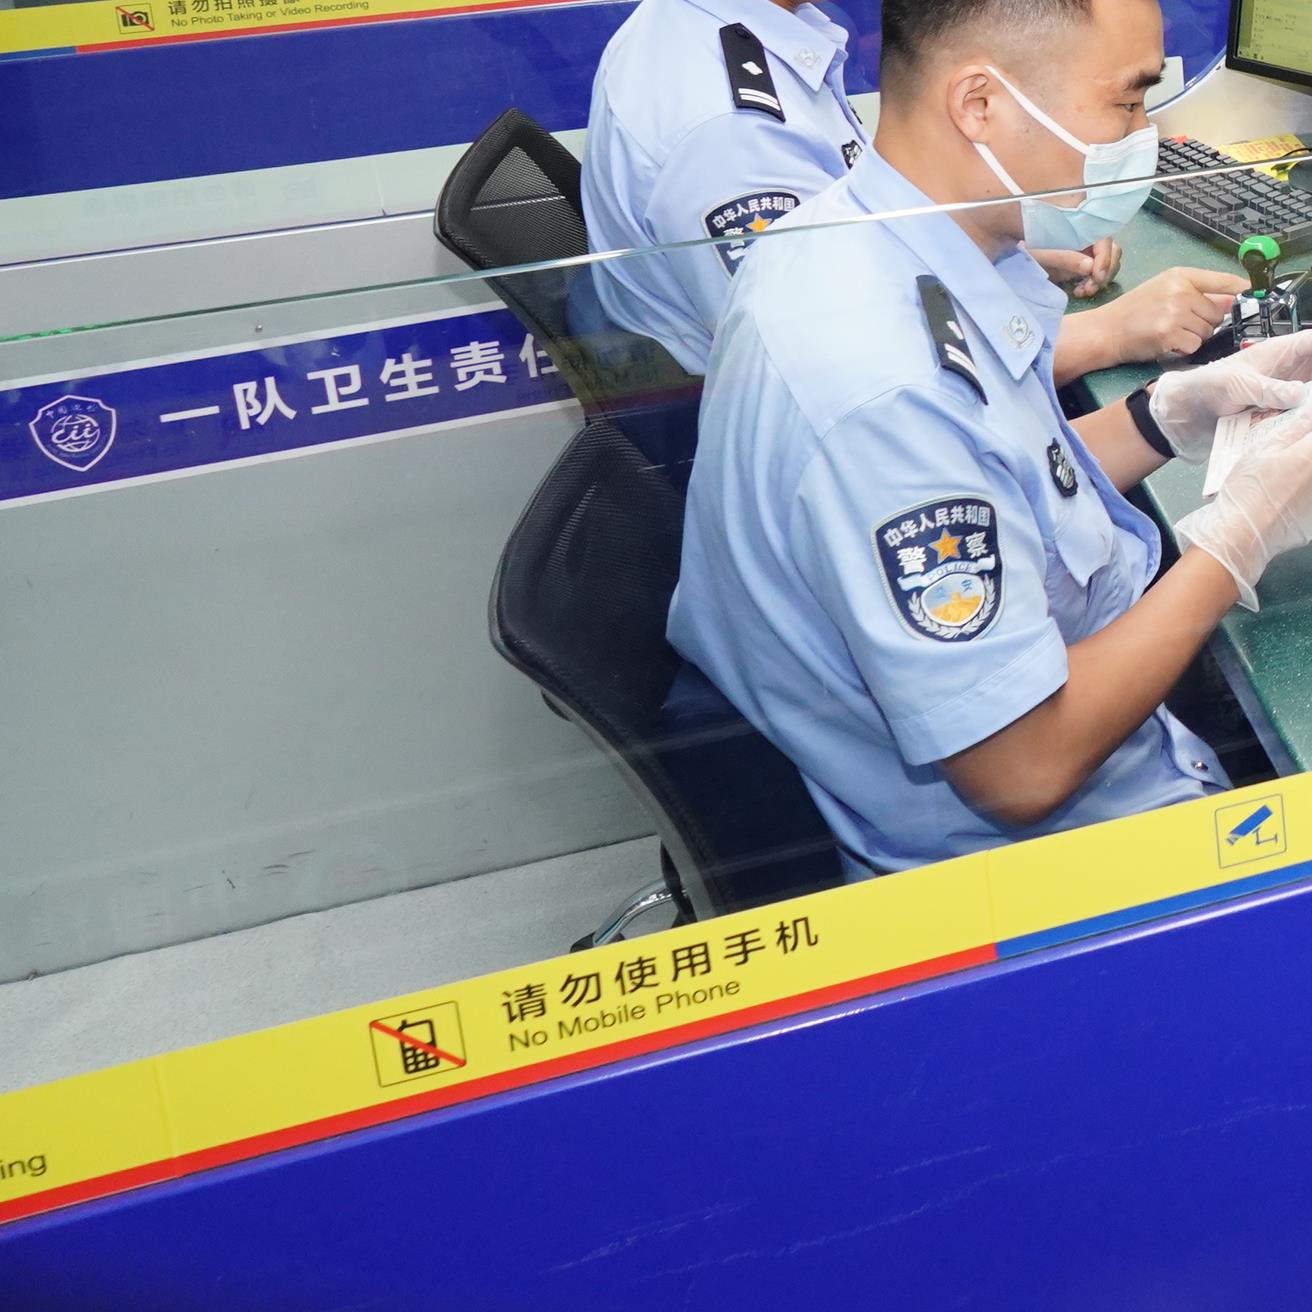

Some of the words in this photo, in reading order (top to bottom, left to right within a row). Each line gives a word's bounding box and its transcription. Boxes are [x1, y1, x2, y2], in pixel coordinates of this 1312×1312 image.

[171, 18, 188, 28] No
[190, 14, 225, 26] Photo
[227, 10, 263, 24] Taking
[265, 10, 277, 19] or
[279, 5, 312, 17] Video
[314, 0, 370, 14] Recording
[712, 196, 796, 229] 中华人民共和国
[883, 504, 991, 548] 中华人民共和国
[502, 916, 819, 1024] 请勿使用手机
[508, 1028, 548, 1053] No
[557, 1001, 647, 1040] Mobile
[656, 978, 741, 1015] Phone
